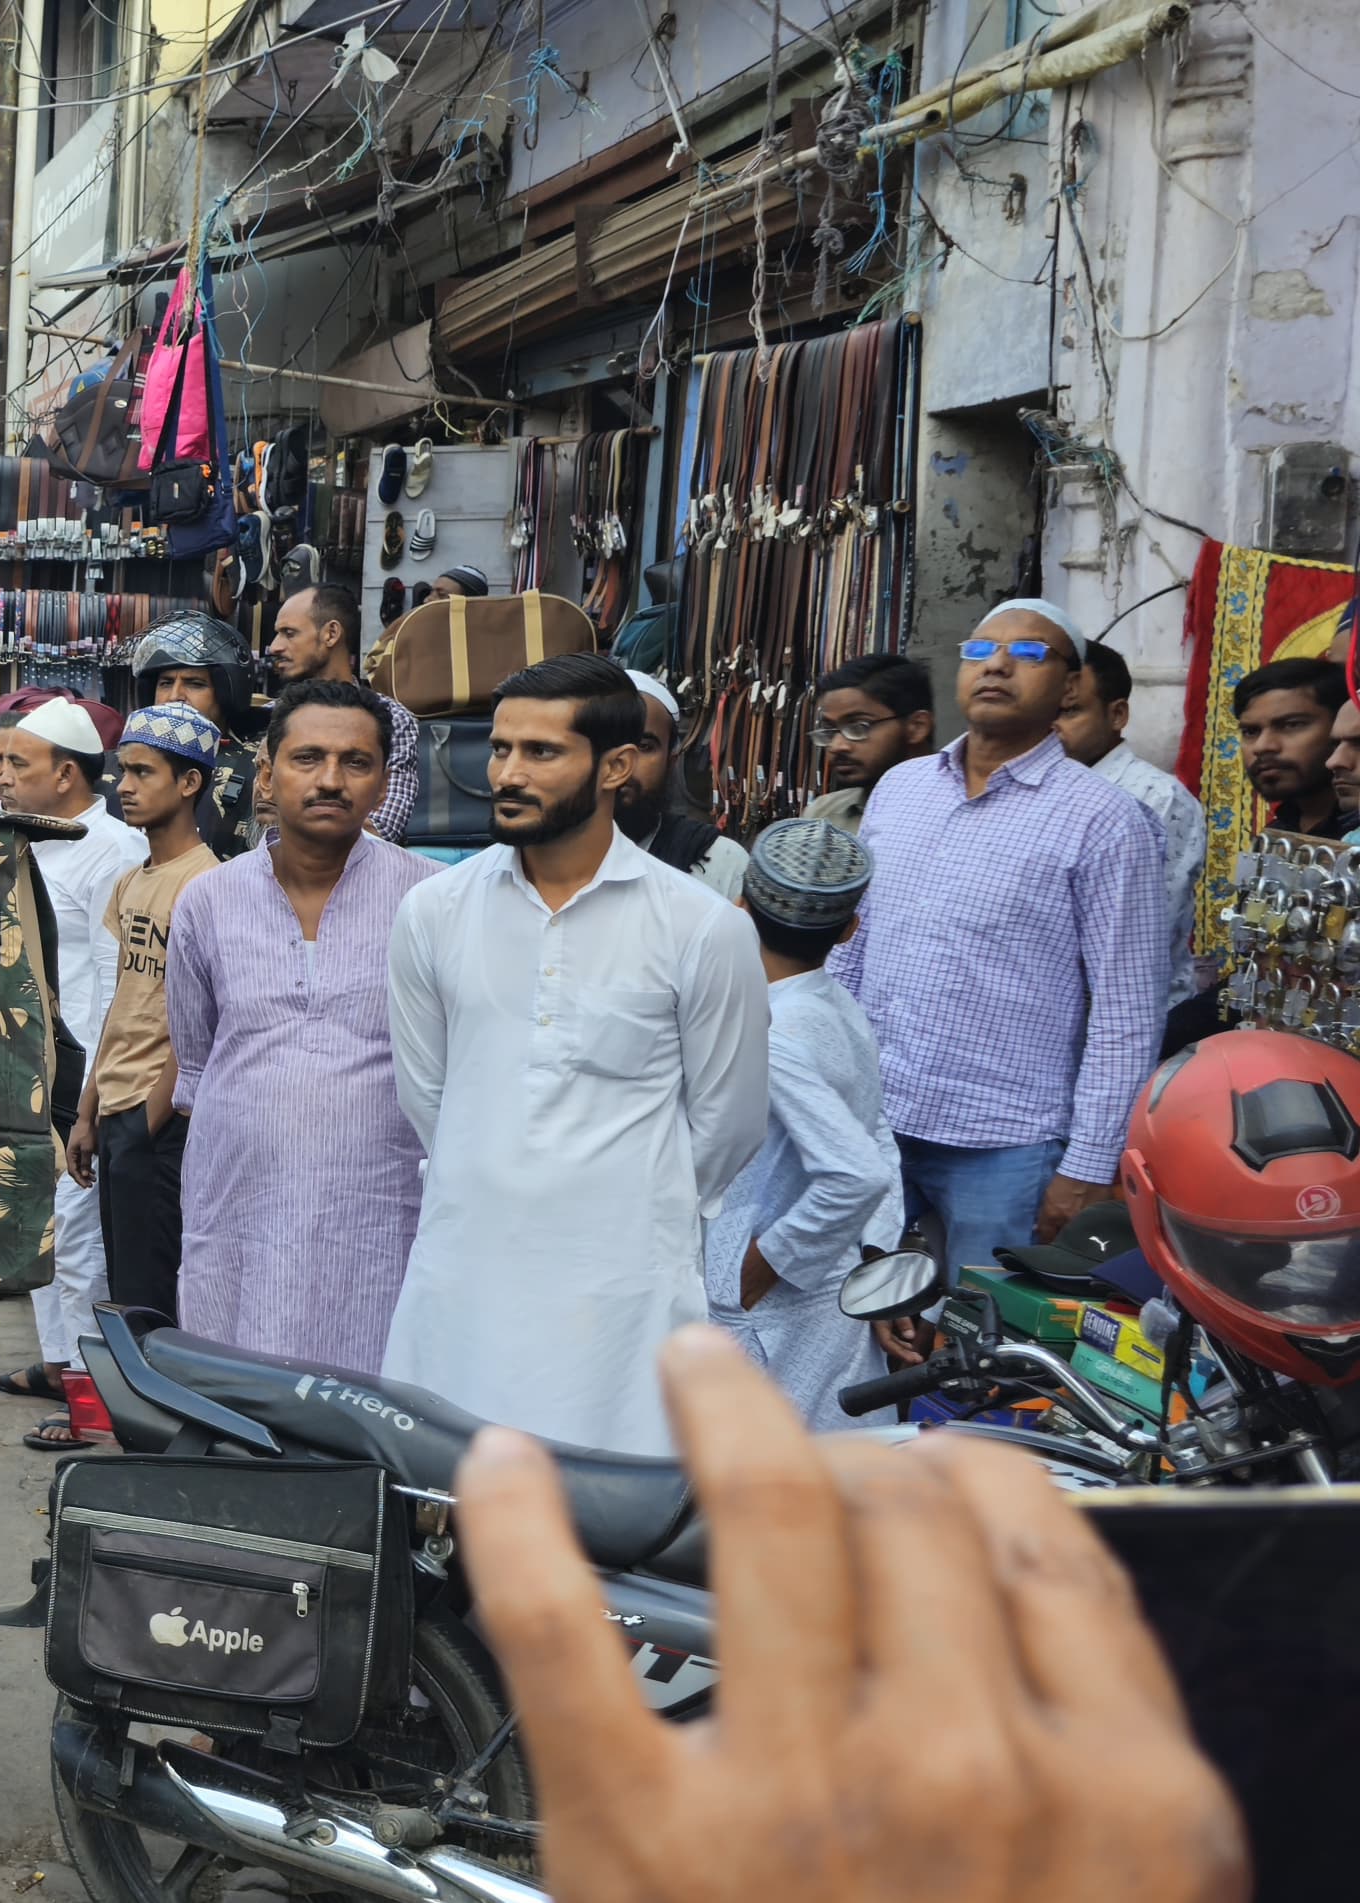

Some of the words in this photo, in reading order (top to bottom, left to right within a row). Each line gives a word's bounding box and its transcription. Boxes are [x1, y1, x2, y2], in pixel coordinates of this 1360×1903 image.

[1082, 1307, 1119, 1343] GENUINE
[337, 1387, 416, 1431] Hero
[188, 1619, 264, 1655] Apple
